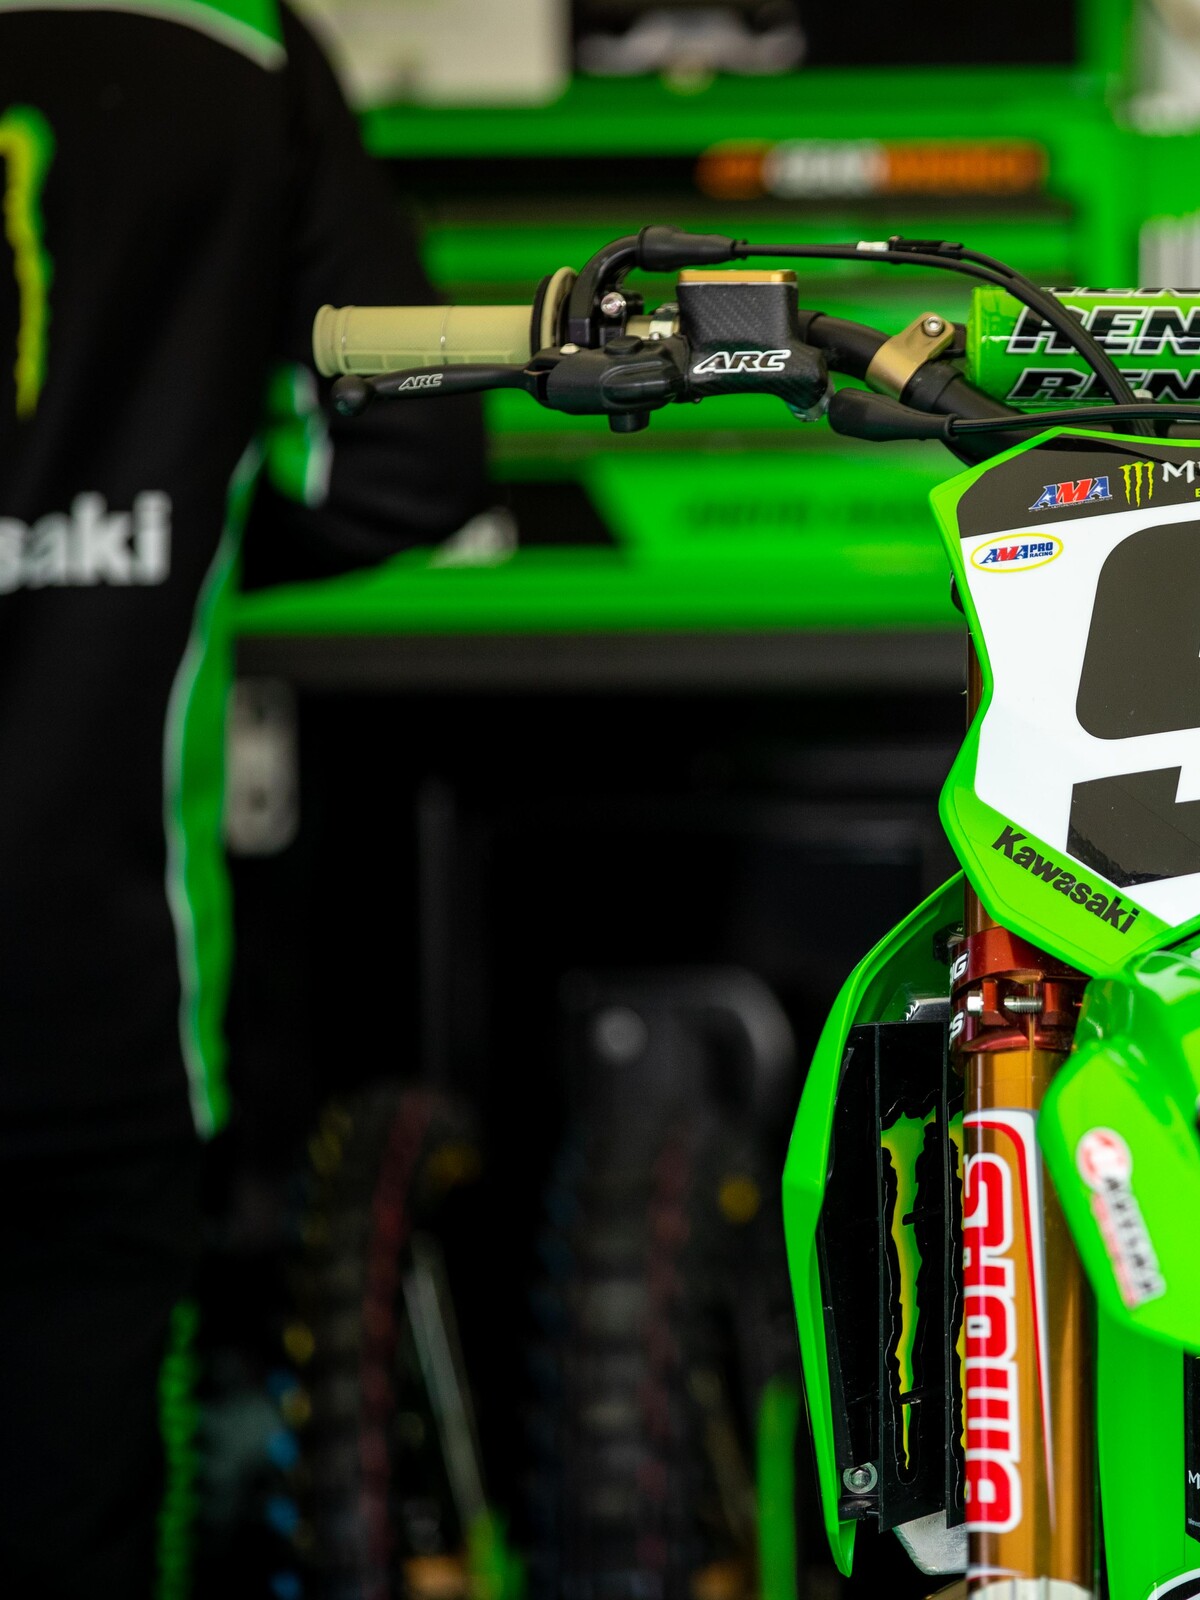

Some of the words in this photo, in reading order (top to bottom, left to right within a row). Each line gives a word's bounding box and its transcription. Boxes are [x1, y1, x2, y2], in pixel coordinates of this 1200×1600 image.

[693, 349, 792, 374] ARC
[398, 373, 443, 391] ARC
[1028, 475, 1112, 509] AMA
[979, 544, 1029, 564] AMA
[1030, 541, 1053, 552] PRO
[991, 825, 1140, 934] Kawasaki
